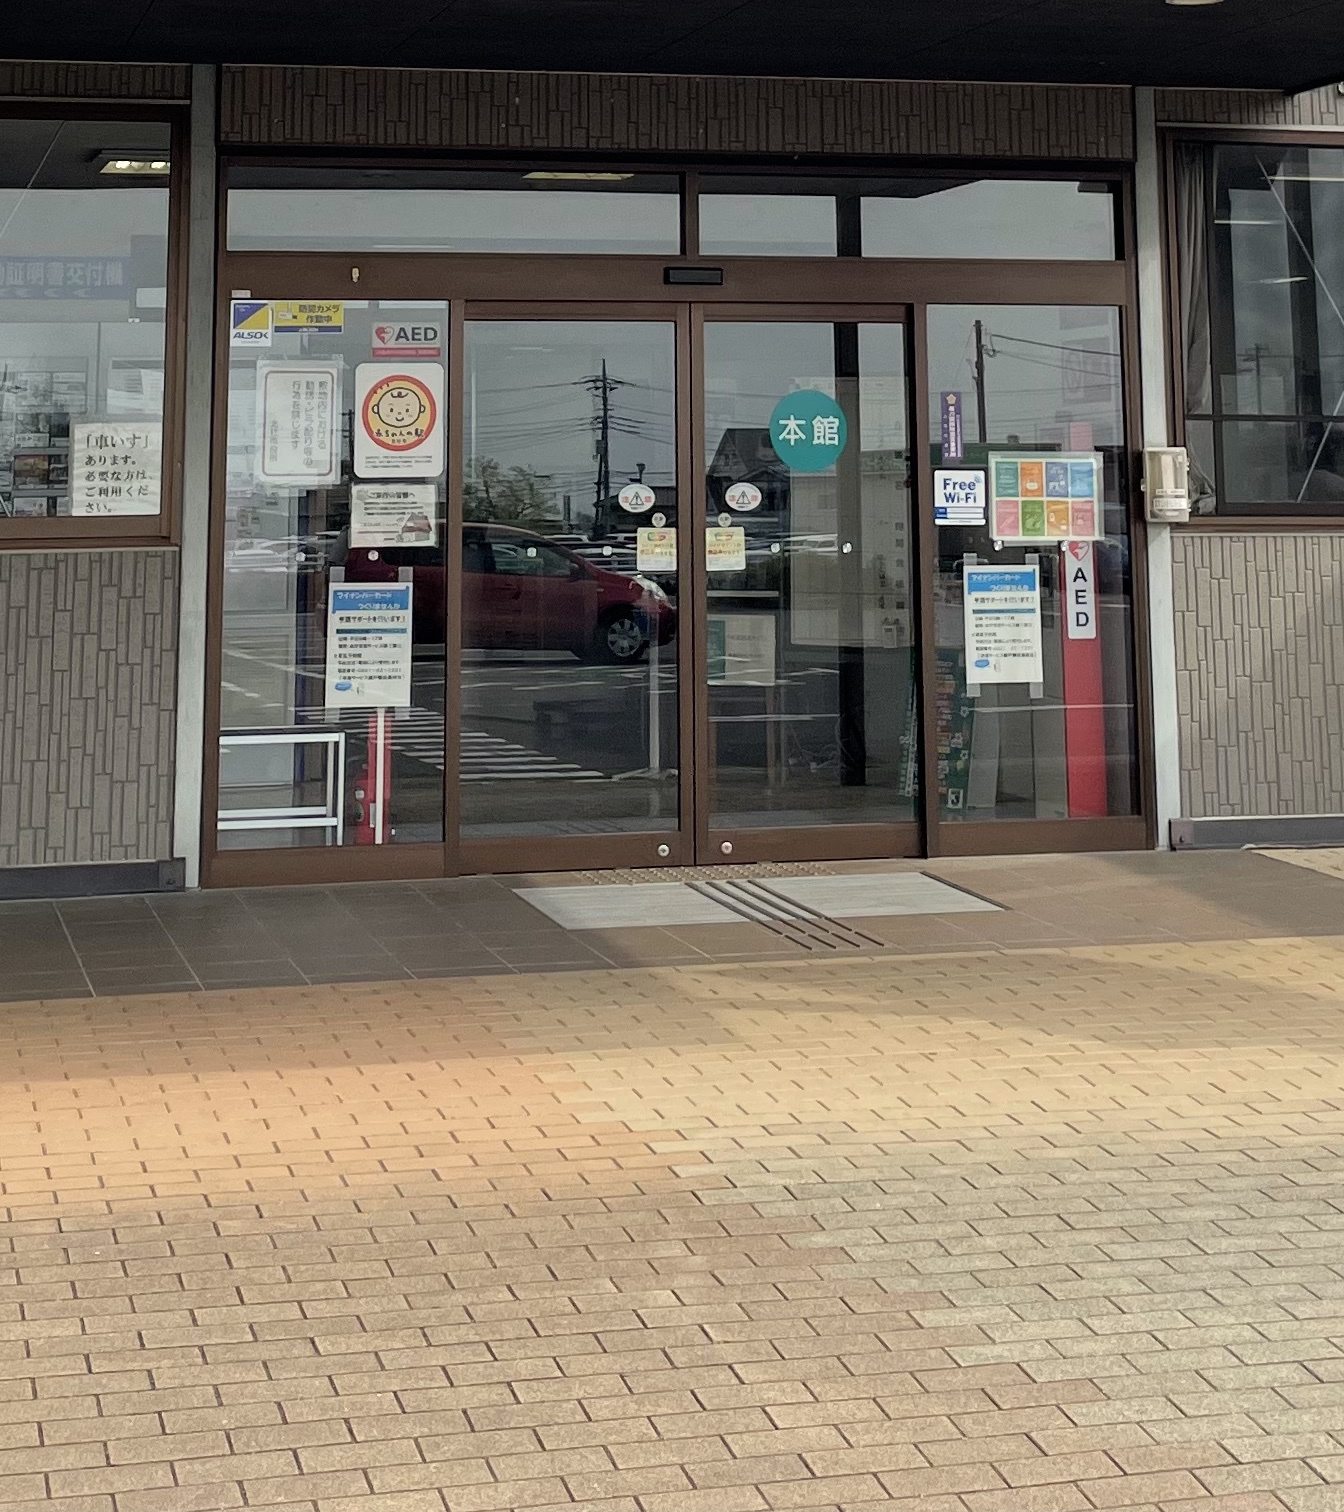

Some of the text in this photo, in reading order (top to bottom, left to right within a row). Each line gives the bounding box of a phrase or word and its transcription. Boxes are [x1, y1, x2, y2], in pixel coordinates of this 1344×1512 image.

[233, 331, 269, 340] ALSOK
[394, 326, 438, 342] AED
[778, 415, 840, 446] 本館
[85, 454, 136, 466] あります。
[943, 478, 976, 490] Free
[85, 485, 149, 497] ご利用くだ
[943, 492, 977, 504] Wi-Fi
[86, 502, 112, 513] さい。
[1073, 567, 1089, 627] AED
